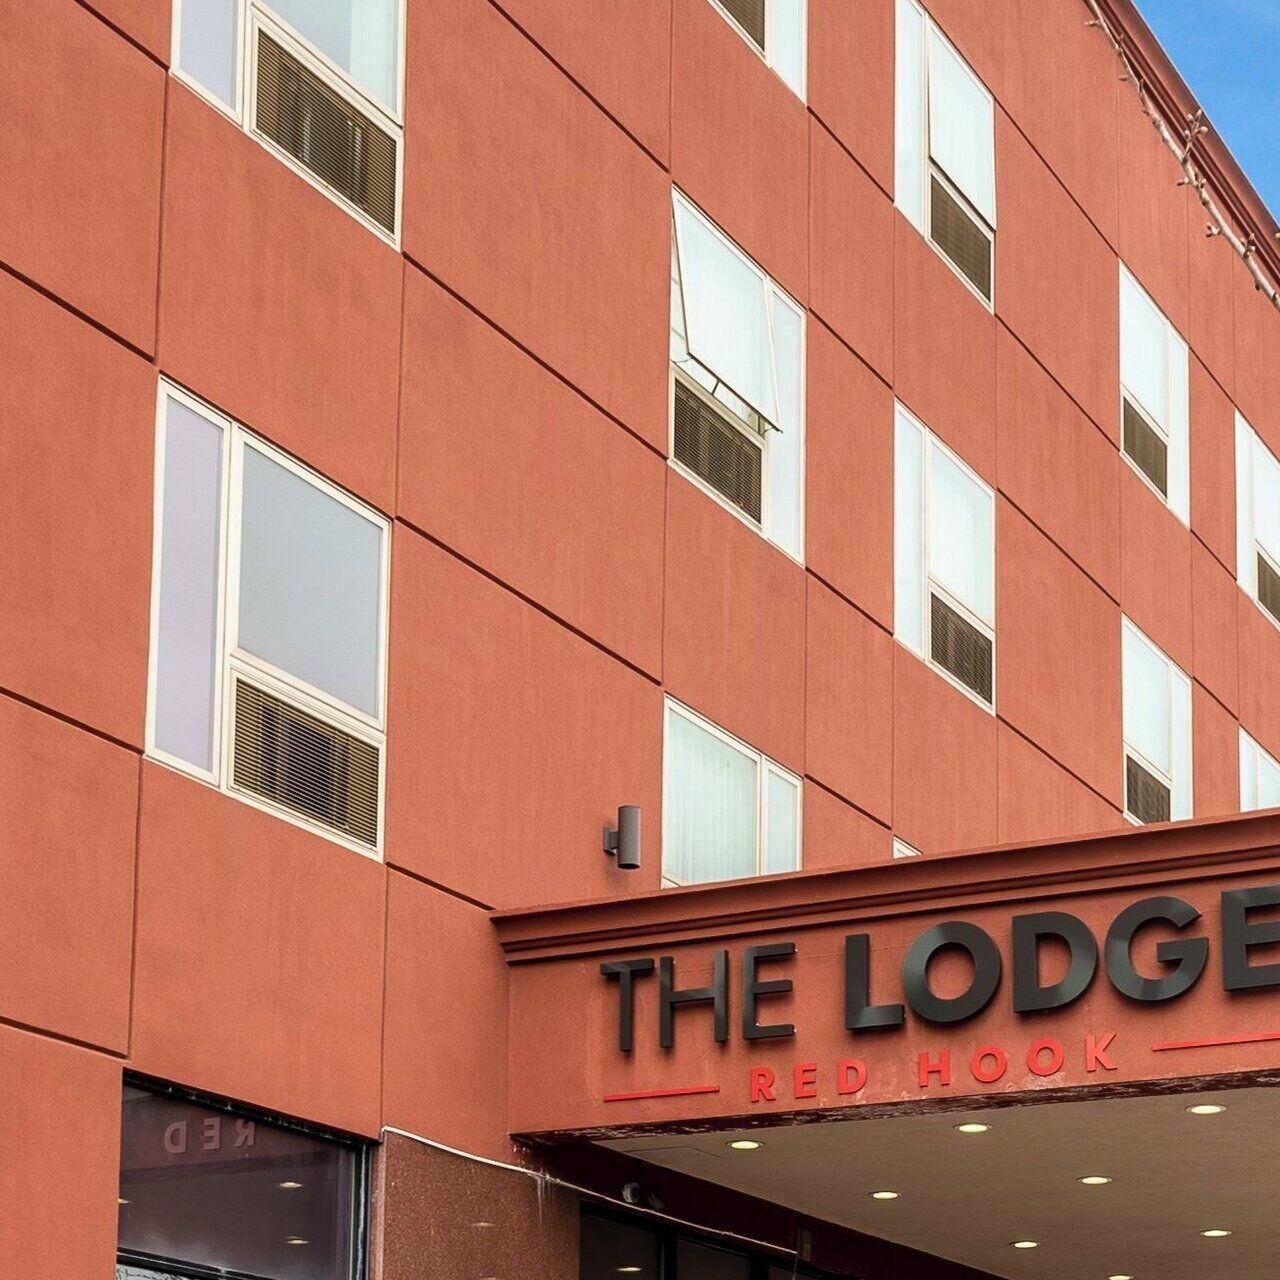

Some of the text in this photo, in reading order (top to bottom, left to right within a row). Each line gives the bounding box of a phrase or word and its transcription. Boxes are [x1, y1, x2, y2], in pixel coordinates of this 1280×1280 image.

[600, 942, 797, 1052] THE
[749, 1031, 1118, 1103] RED HOOK
